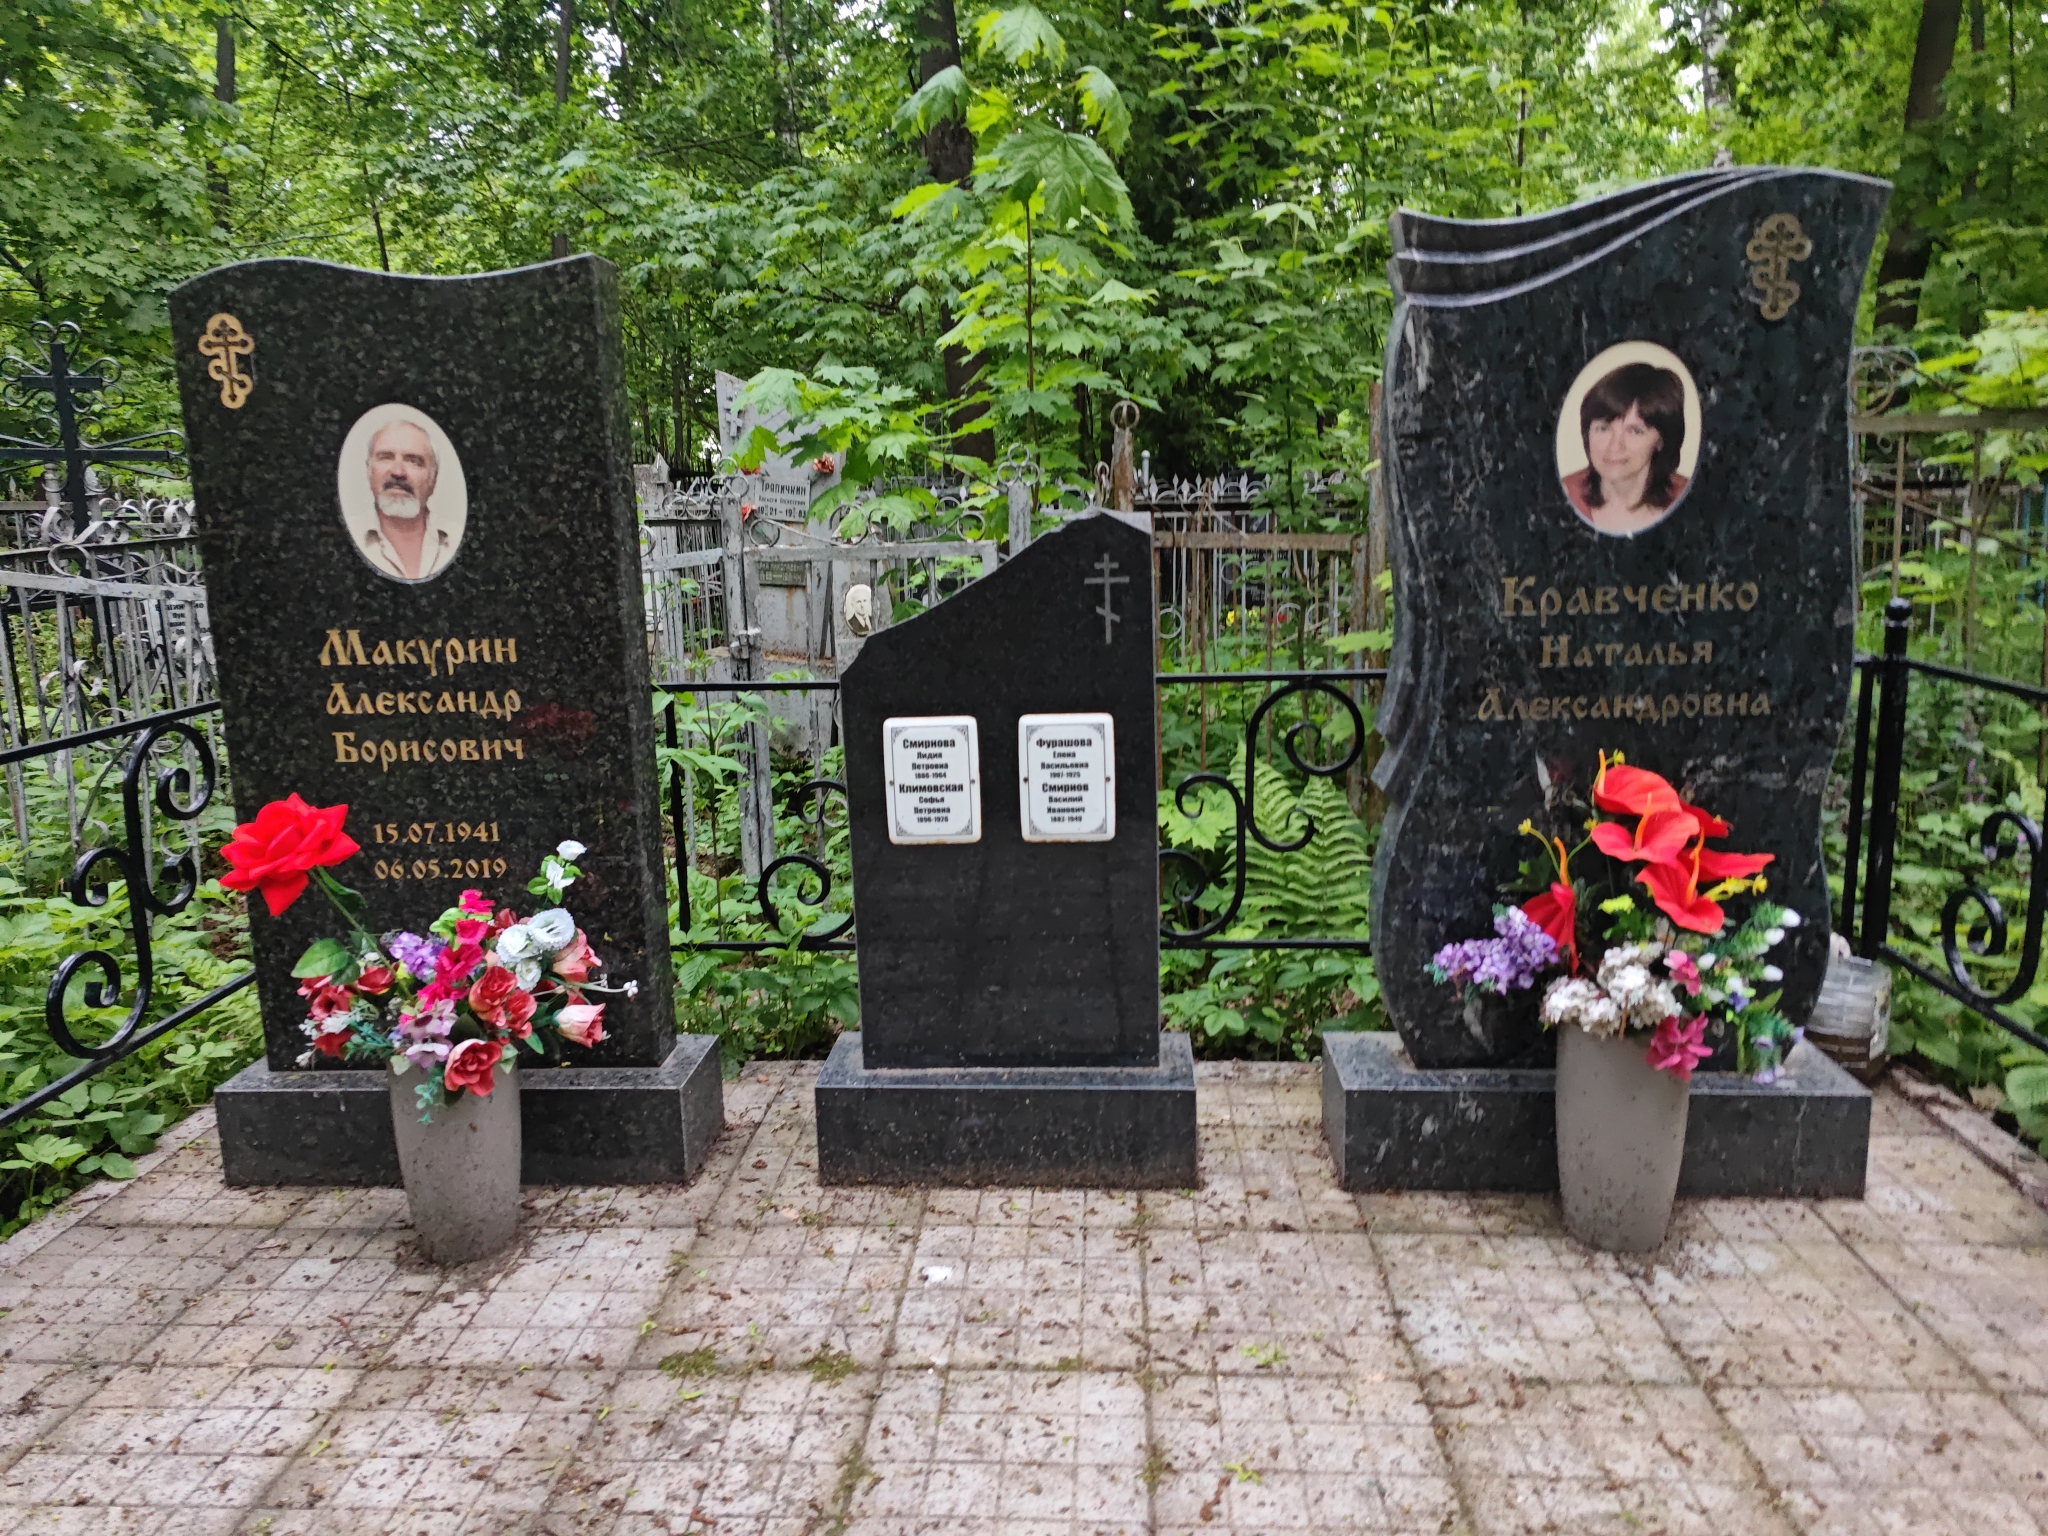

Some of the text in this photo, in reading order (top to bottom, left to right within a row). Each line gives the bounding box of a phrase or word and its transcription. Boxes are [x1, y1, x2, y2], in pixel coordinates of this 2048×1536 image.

[1500, 575, 1759, 628] Кравченко
[318, 629, 518, 677] Макурин
[1539, 634, 1713, 668] Наталья
[326, 682, 522, 722] Александр
[1477, 687, 1772, 727] Александровна
[902, 738, 956, 750] Смирнова
[1036, 738, 1092, 749] Фурашова
[331, 731, 524, 773] Борисович
[916, 751, 943, 760] Лидия
[1052, 751, 1076, 759] Елена
[911, 762, 949, 771] Петровна
[1040, 761, 1089, 770] Васильевна
[899, 783, 964, 794] Климовская
[1041, 782, 1089, 794] Смирнов
[918, 796, 945, 804] Софья
[1048, 795, 1083, 803] Василий
[913, 806, 951, 815] Петровна
[1046, 806, 1086, 814] Иванович
[374, 821, 500, 844] 15.07.1941
[374, 858, 508, 880] 06.05.2019
